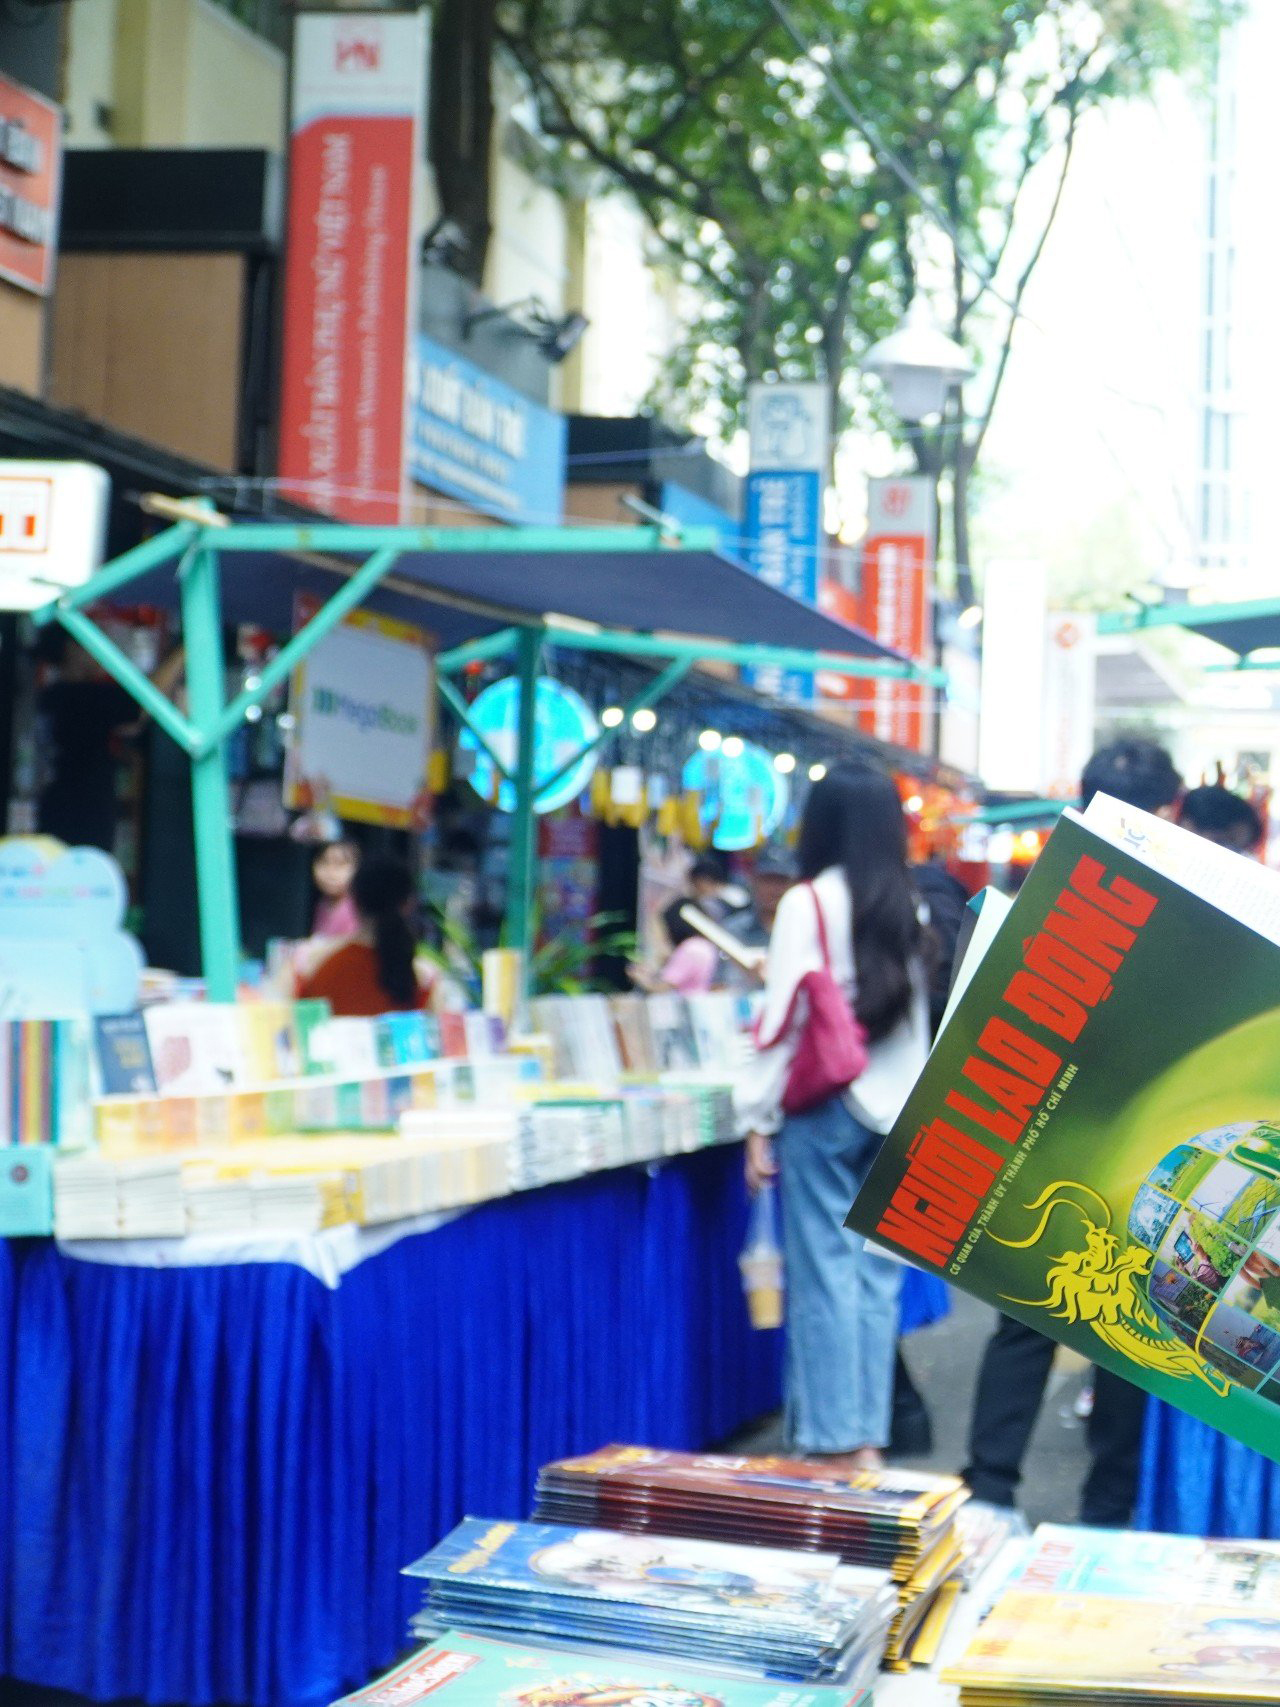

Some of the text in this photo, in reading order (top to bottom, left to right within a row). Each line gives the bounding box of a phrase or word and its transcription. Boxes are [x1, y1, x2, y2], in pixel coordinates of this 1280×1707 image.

[876, 855, 1159, 1267] NGƯỜI LAO ĐỘNG
[957, 1243, 974, 1263] QUAN
[967, 1227, 983, 1243] CỦA
[977, 1198, 999, 1227] THÀNH
[1003, 1151, 1027, 1183] THÀNH
[1022, 1124, 1041, 1150] PHỐ
[1035, 1108, 1051, 1128] HỒ
[1046, 1089, 1063, 1110] CHÍ
[1057, 1064, 1078, 1091] MINH
